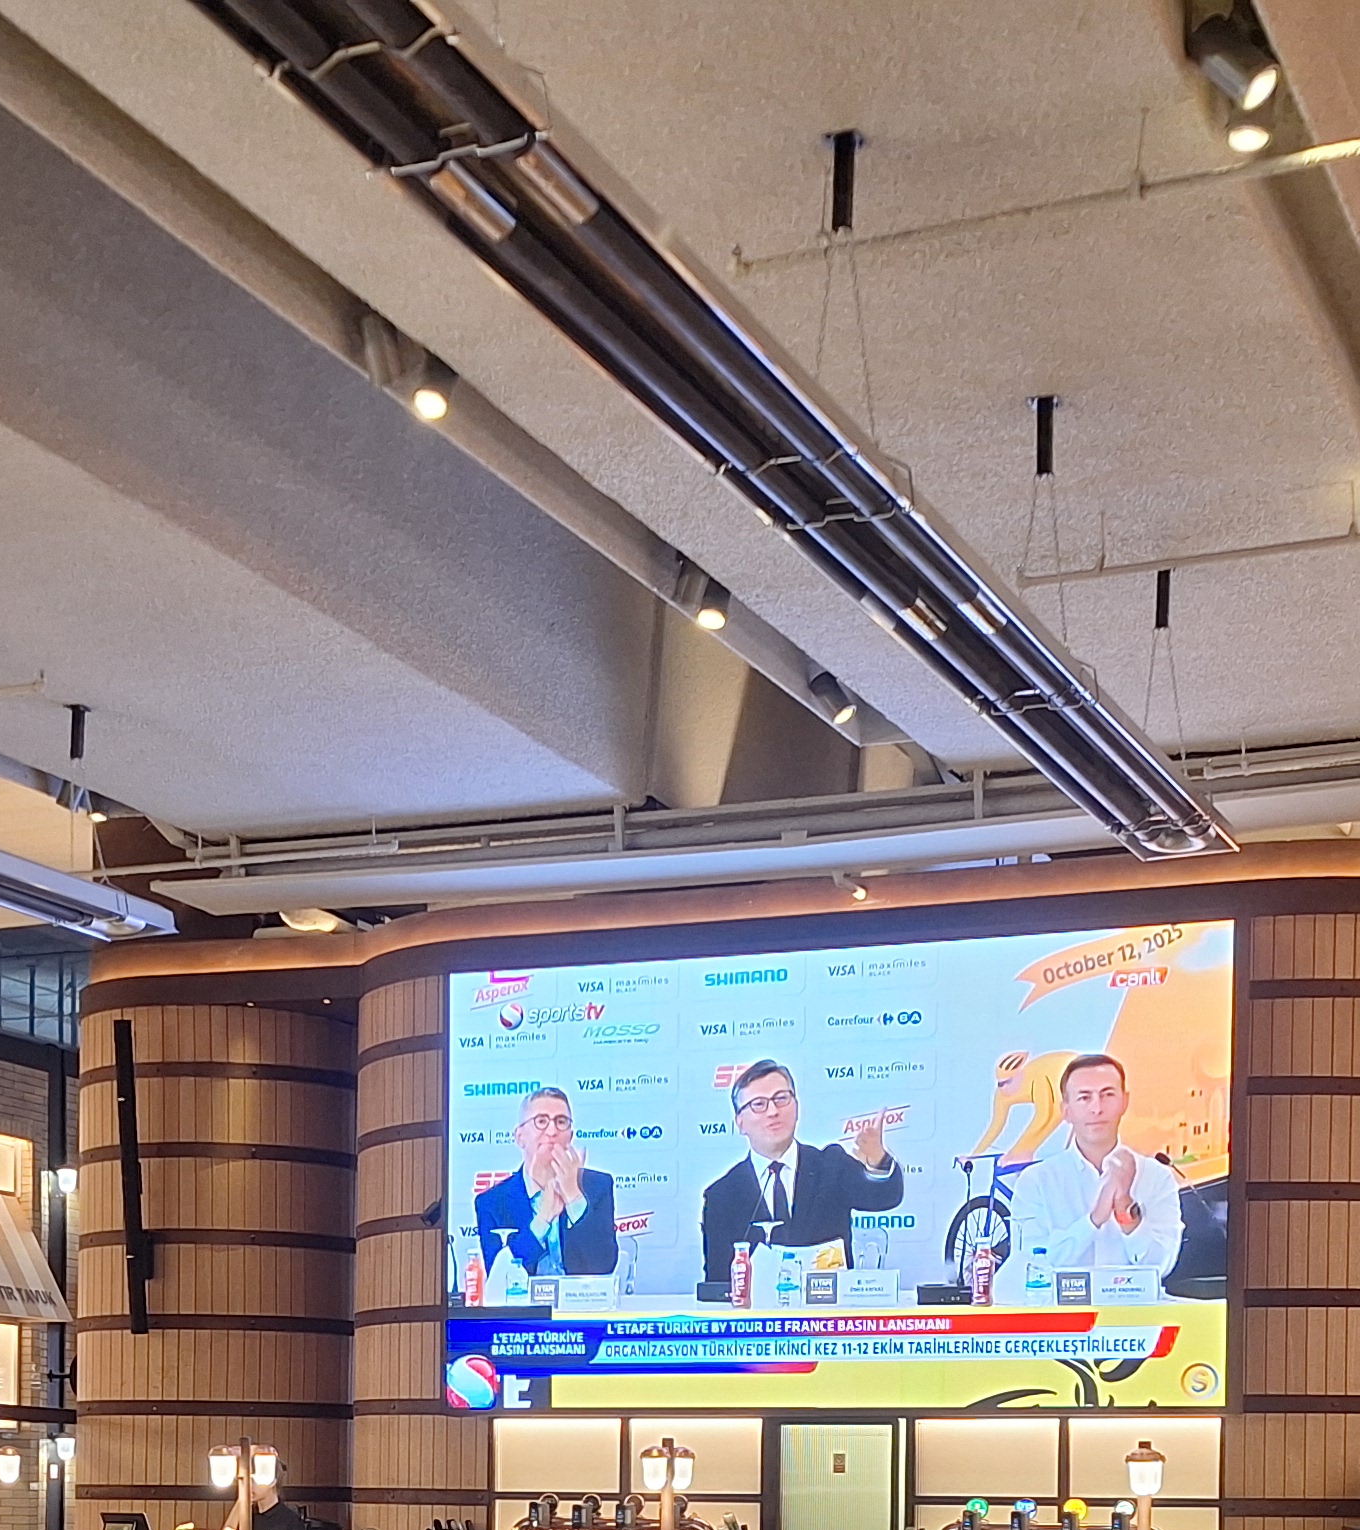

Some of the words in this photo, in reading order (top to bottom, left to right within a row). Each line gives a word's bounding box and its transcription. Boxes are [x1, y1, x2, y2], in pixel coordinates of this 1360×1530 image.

[1043, 951, 1114, 984] October
[1143, 925, 1183, 954] 2025
[704, 968, 789, 986] SHIMANO
[827, 964, 856, 977] VISA
[475, 980, 530, 1003] Asperox
[577, 982, 605, 993] VISA
[827, 1014, 875, 1027] Carrefour
[582, 1023, 661, 1039] MOSSO
[699, 1024, 728, 1036] VISA
[458, 1036, 485, 1048] VISA
[825, 1066, 855, 1079] VISA
[577, 1080, 605, 1091] VISA
[575, 1128, 619, 1139] Carrefour
[699, 1123, 727, 1135] VISA
[459, 1132, 485, 1143] VISA
[851, 1215, 915, 1229] IMANO
[16, 1287, 58, 1307] TAVUK
[606, 1322, 655, 1335] L'ETAPE
[711, 1321, 728, 1333] BY
[729, 1321, 764, 1333] TOUR
[765, 1321, 783, 1333] DE
[784, 1320, 835, 1332] FRANCE
[837, 1319, 878, 1332] BASIN
[879, 1318, 950, 1331] LANSMANI
[492, 1332, 536, 1344] L'ETAPE
[537, 1329, 584, 1343] TÜRKİYE
[491, 1344, 525, 1357] BASIN
[526, 1343, 586, 1355] LANSMANI
[605, 1340, 698, 1357] ORGANİZASYON
[701, 1339, 771, 1357] TÜRKİYE'DE
[774, 1338, 811, 1356] İKİNCİ
[814, 1342, 838, 1356] KEZ
[841, 1342, 869, 1355] 11-12
[872, 1338, 904, 1355] EKİM
[907, 1336, 1001, 1355] TARİHLERİNDE
[1004, 1335, 1146, 1357] GERÇEKLEŞTİRİLECEK
